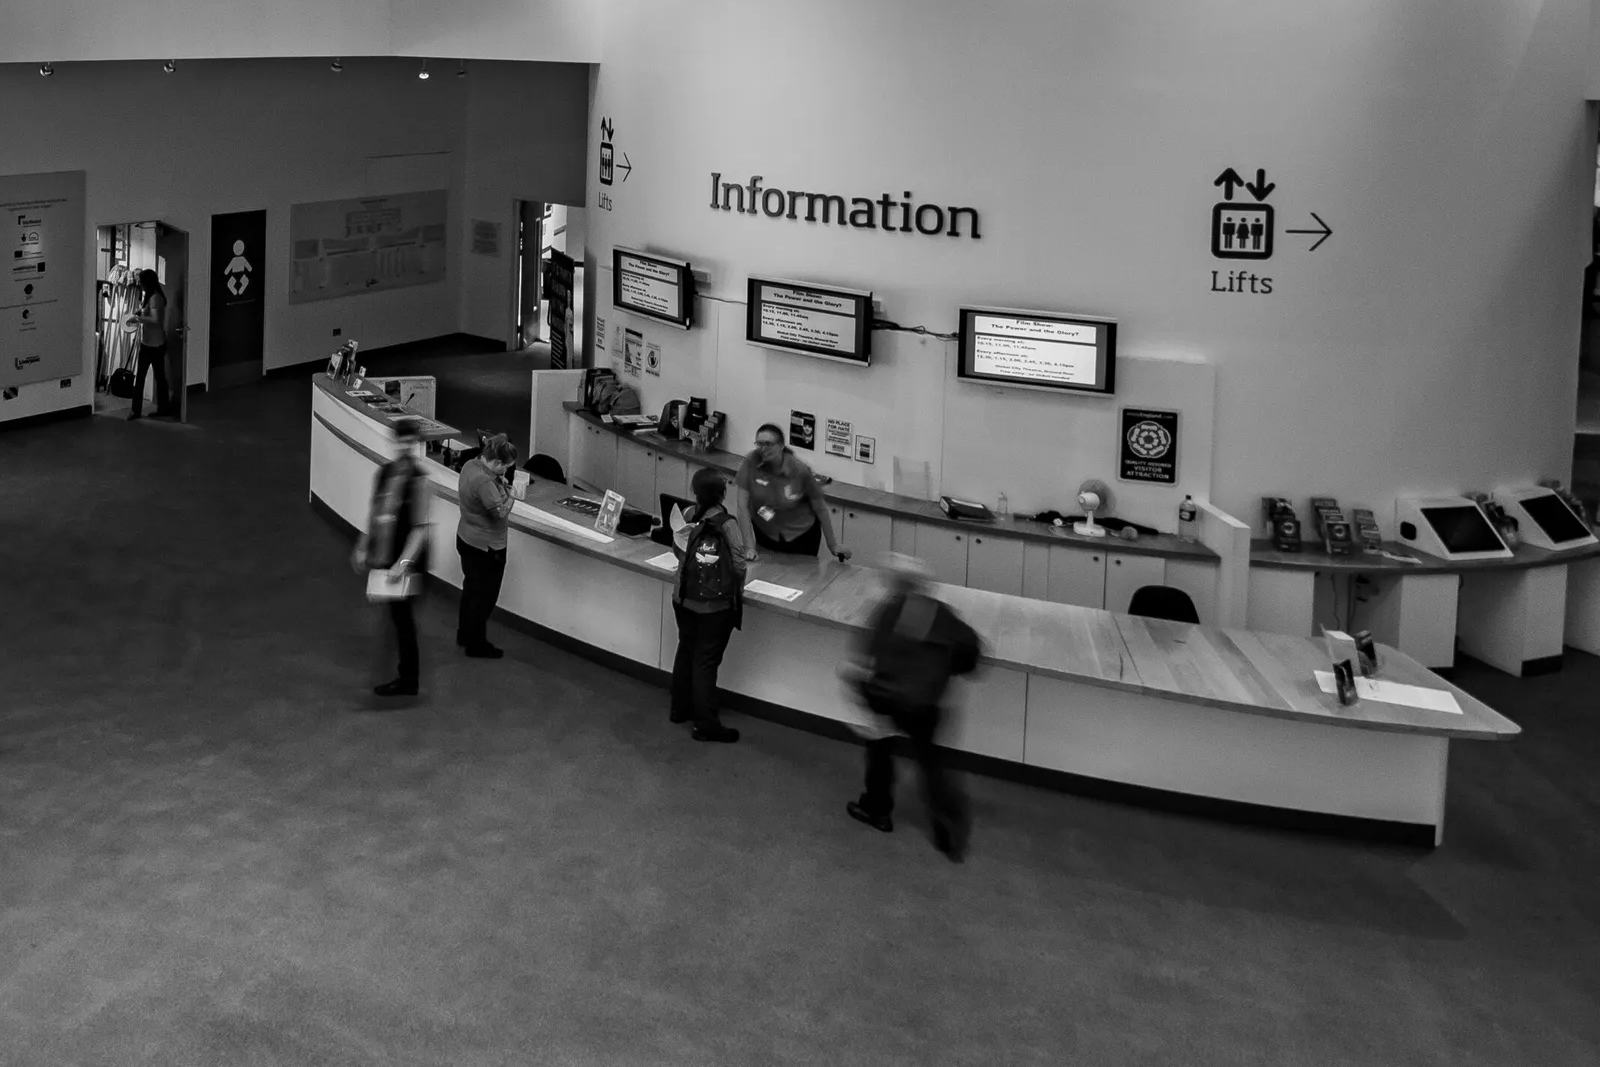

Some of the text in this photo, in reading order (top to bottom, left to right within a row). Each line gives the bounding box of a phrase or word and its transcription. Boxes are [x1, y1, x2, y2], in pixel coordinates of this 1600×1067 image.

[599, 192, 612, 212] Lifts
[710, 172, 981, 239] Information
[1211, 270, 1273, 294] Lifts
[1126, 471, 1169, 479] ATTRACTION
